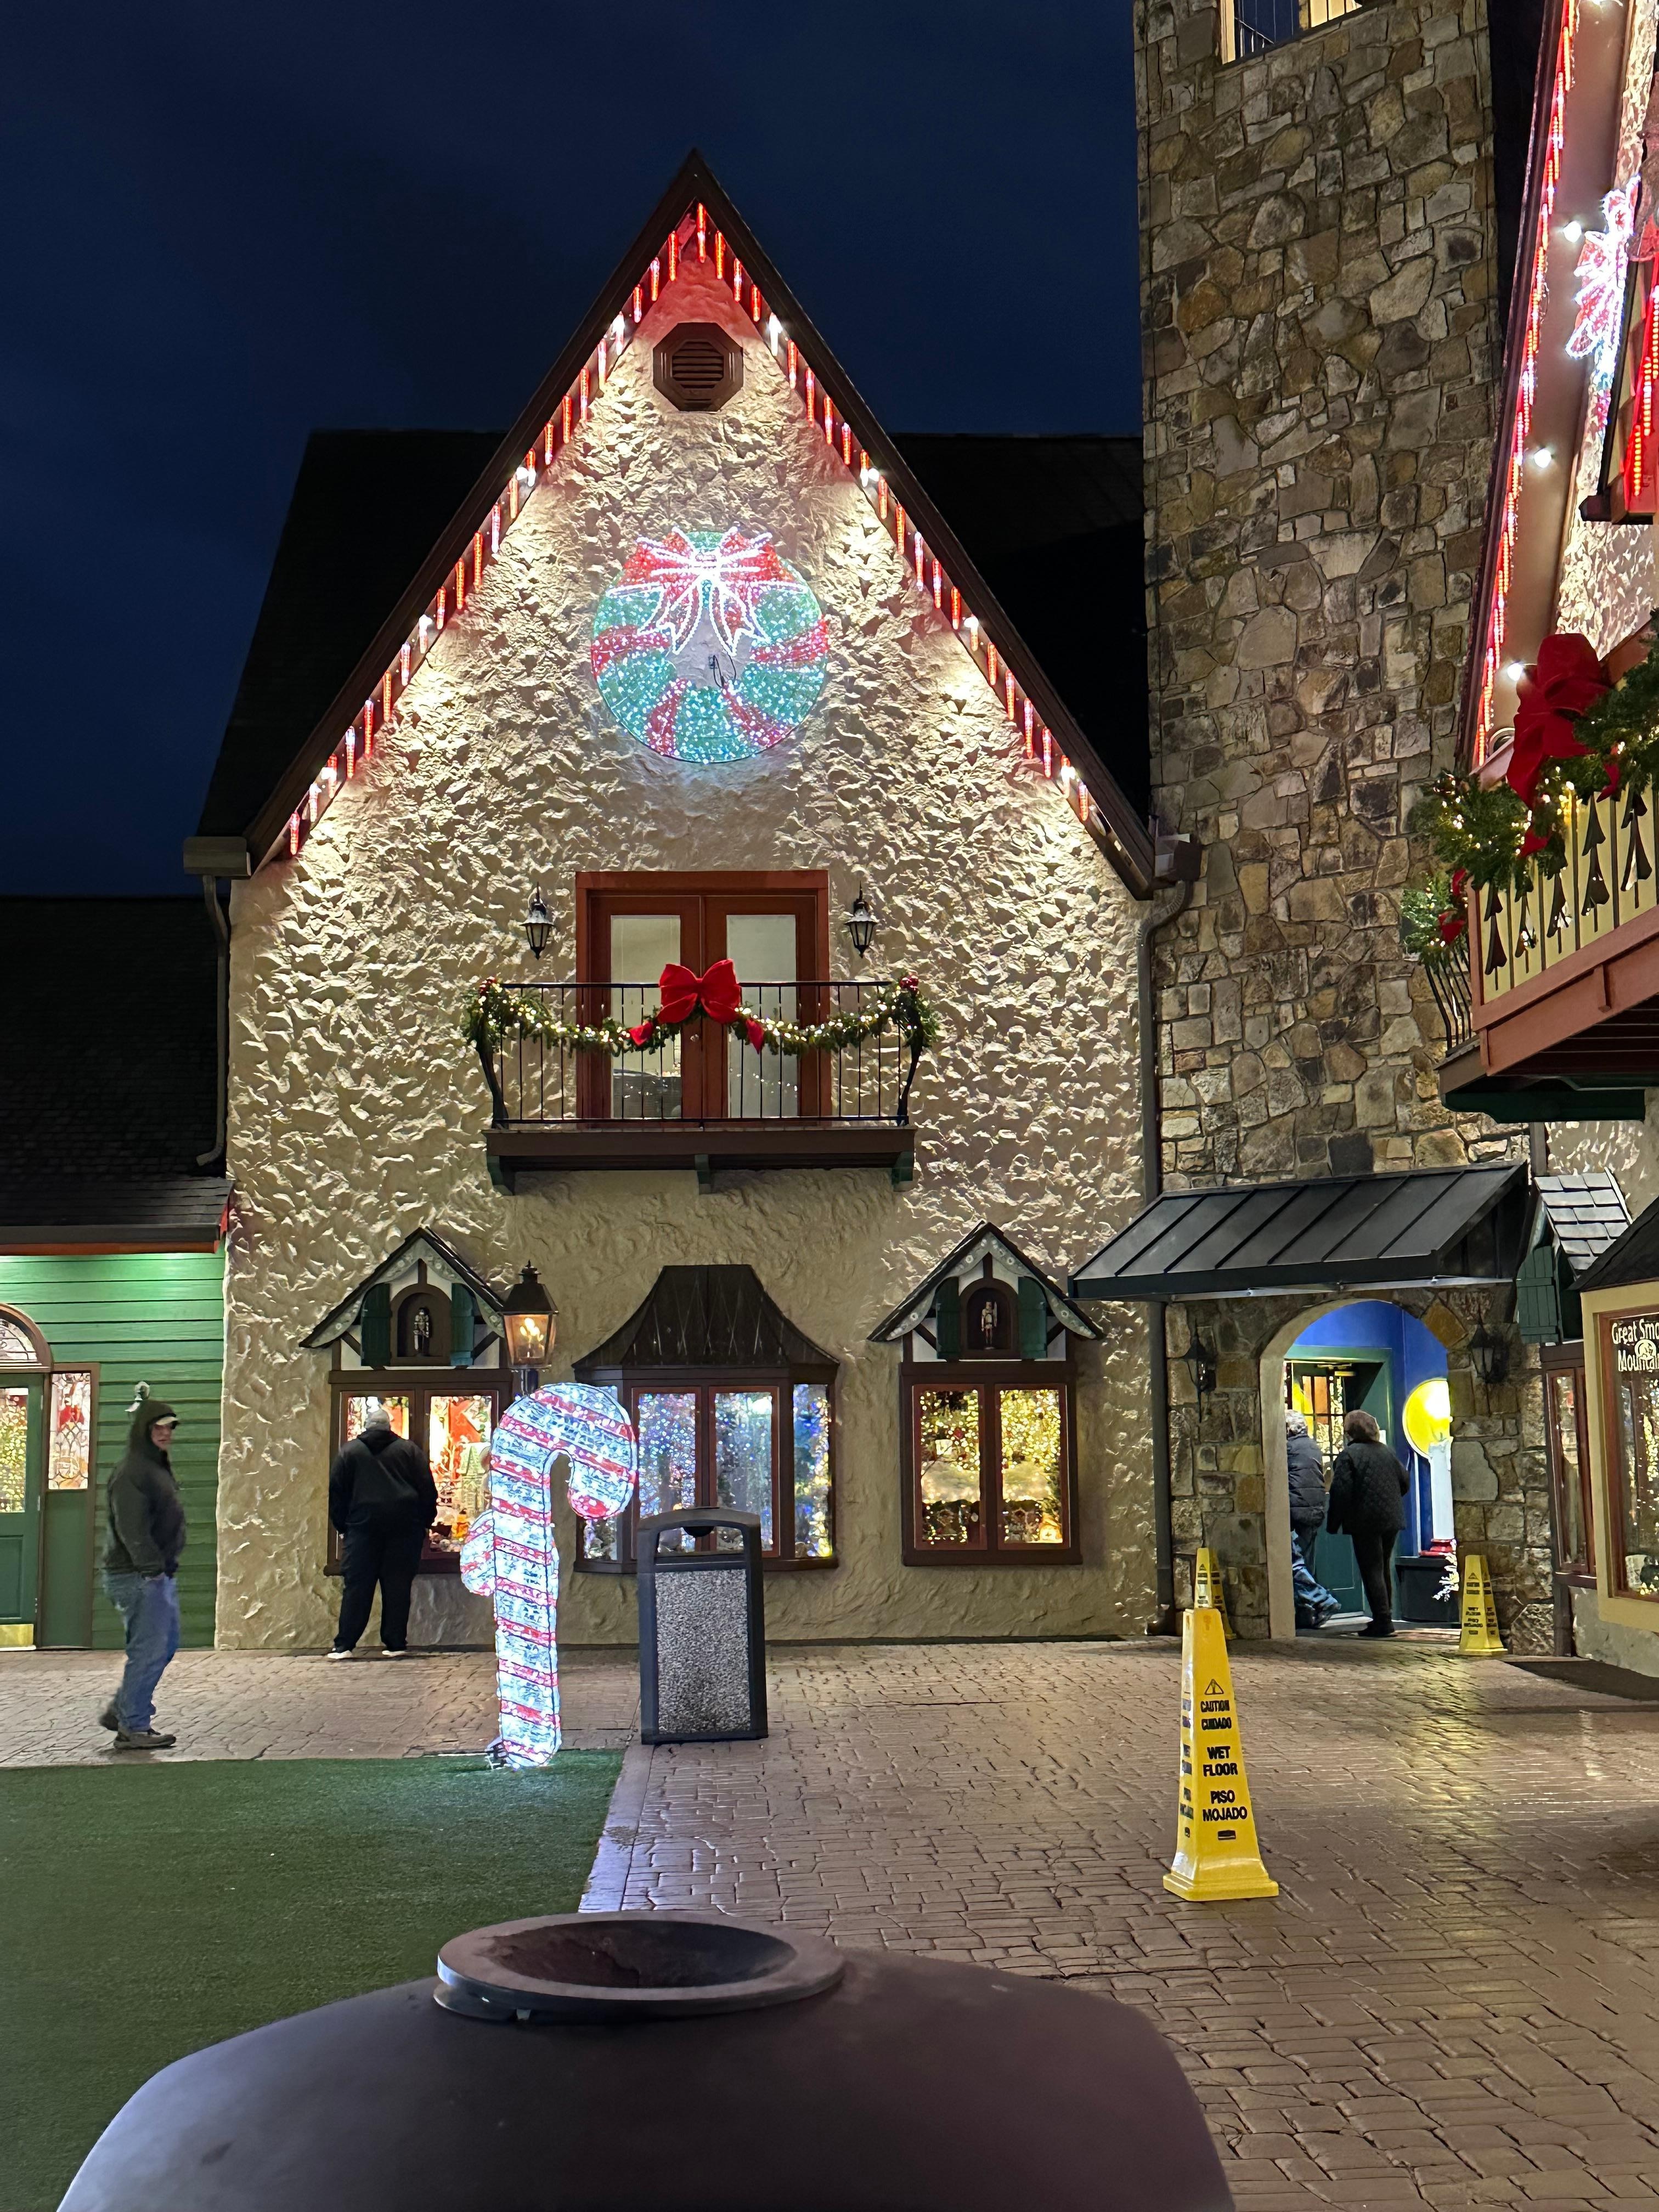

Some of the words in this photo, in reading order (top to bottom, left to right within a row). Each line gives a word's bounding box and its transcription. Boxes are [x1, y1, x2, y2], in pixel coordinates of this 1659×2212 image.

[1612, 1321, 1638, 1344] Great
[1618, 1350, 1659, 1372] Mountai
[1200, 1700, 1230, 1712] CAUTION
[1201, 1717, 1232, 1730] CUIDADO
[1207, 1746, 1231, 1759] WET
[1203, 1763, 1238, 1777] FLOOR
[1210, 1790, 1235, 1804] PISO
[1202, 1806, 1248, 1821] MOJADO
